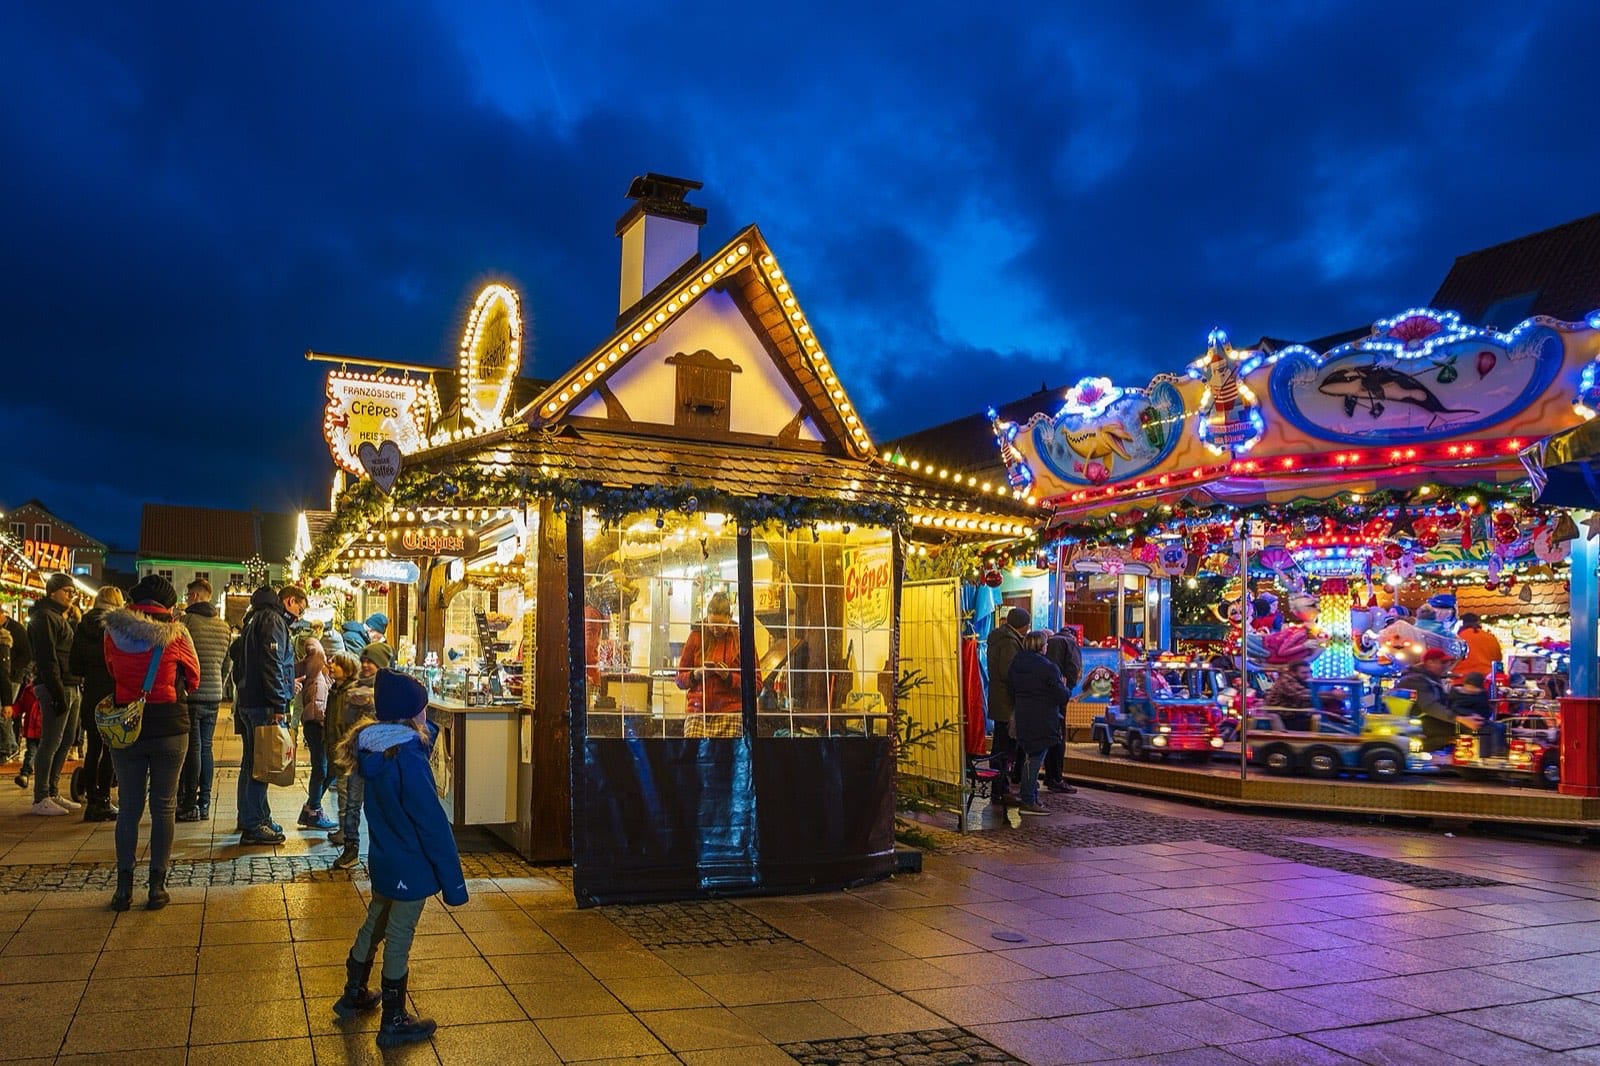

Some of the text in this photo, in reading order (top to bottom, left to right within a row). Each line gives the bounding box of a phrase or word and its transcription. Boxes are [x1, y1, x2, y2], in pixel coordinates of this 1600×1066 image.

[343, 385, 407, 401] FRANZÖSISCHE
[351, 400, 398, 418] Crêpes
[24, 538, 70, 570] PIZZA
[845, 562, 889, 603] Crêpes
